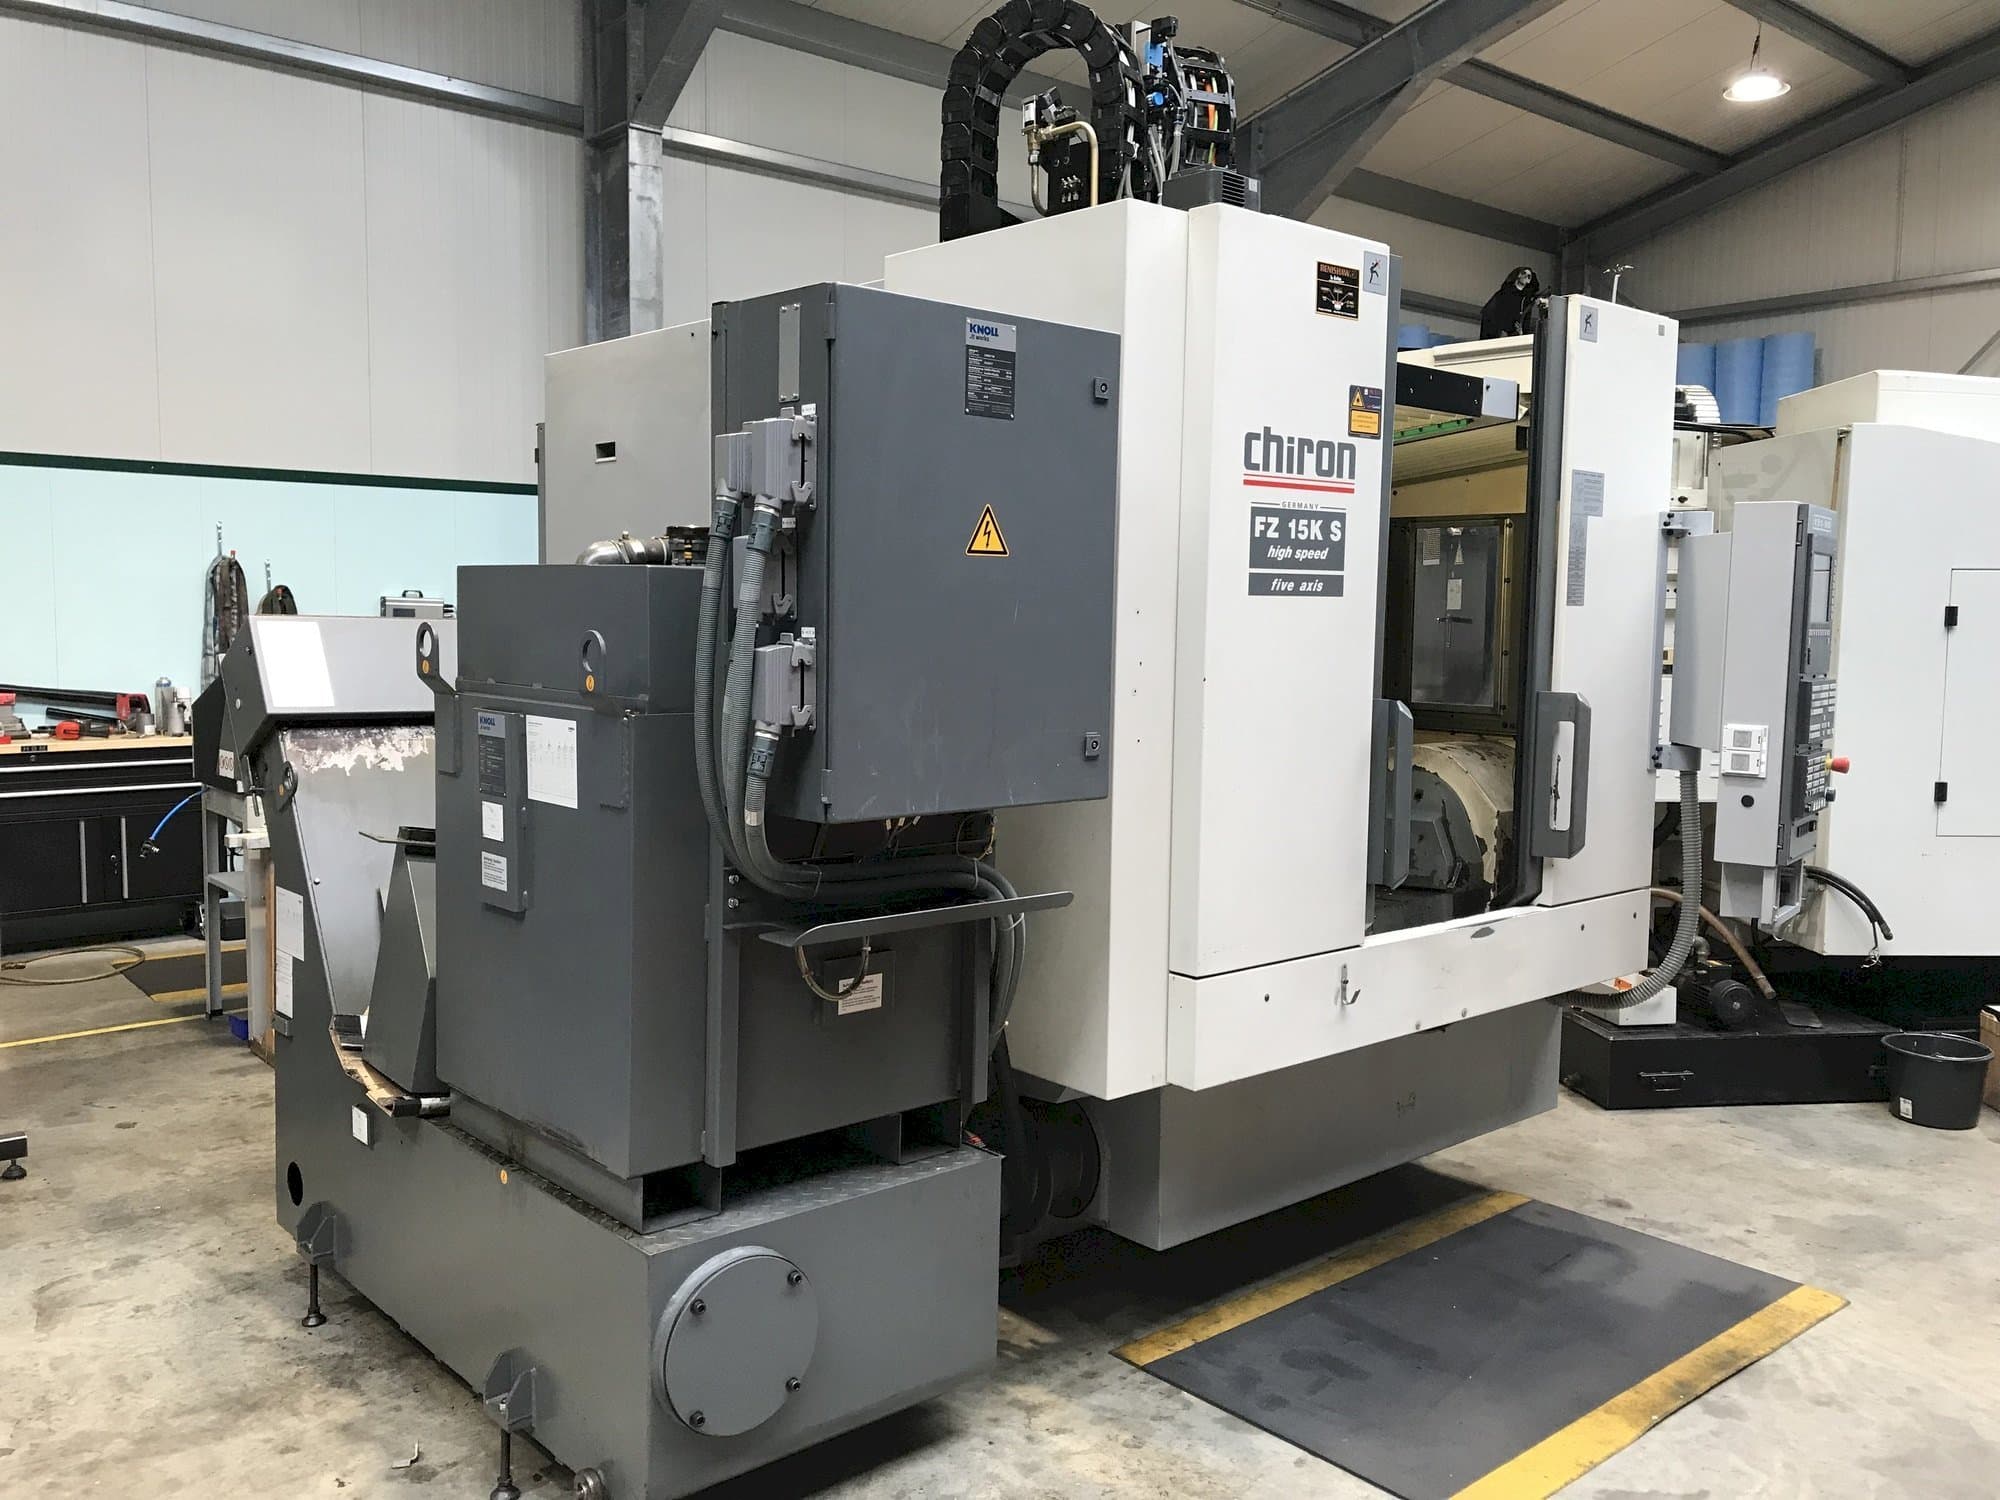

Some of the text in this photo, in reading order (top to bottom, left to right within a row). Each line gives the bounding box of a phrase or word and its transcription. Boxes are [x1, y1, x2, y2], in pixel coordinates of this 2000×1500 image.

[970, 323, 999, 336] KNOLL
[1243, 426, 1356, 480] chiron
[1281, 501, 1319, 510] GERMANY
[1254, 515, 1342, 542] FZ 15K S
[1267, 545, 1329, 562] high speed
[1270, 578, 1324, 592] five axis
[480, 716, 495, 725] KNOLL
